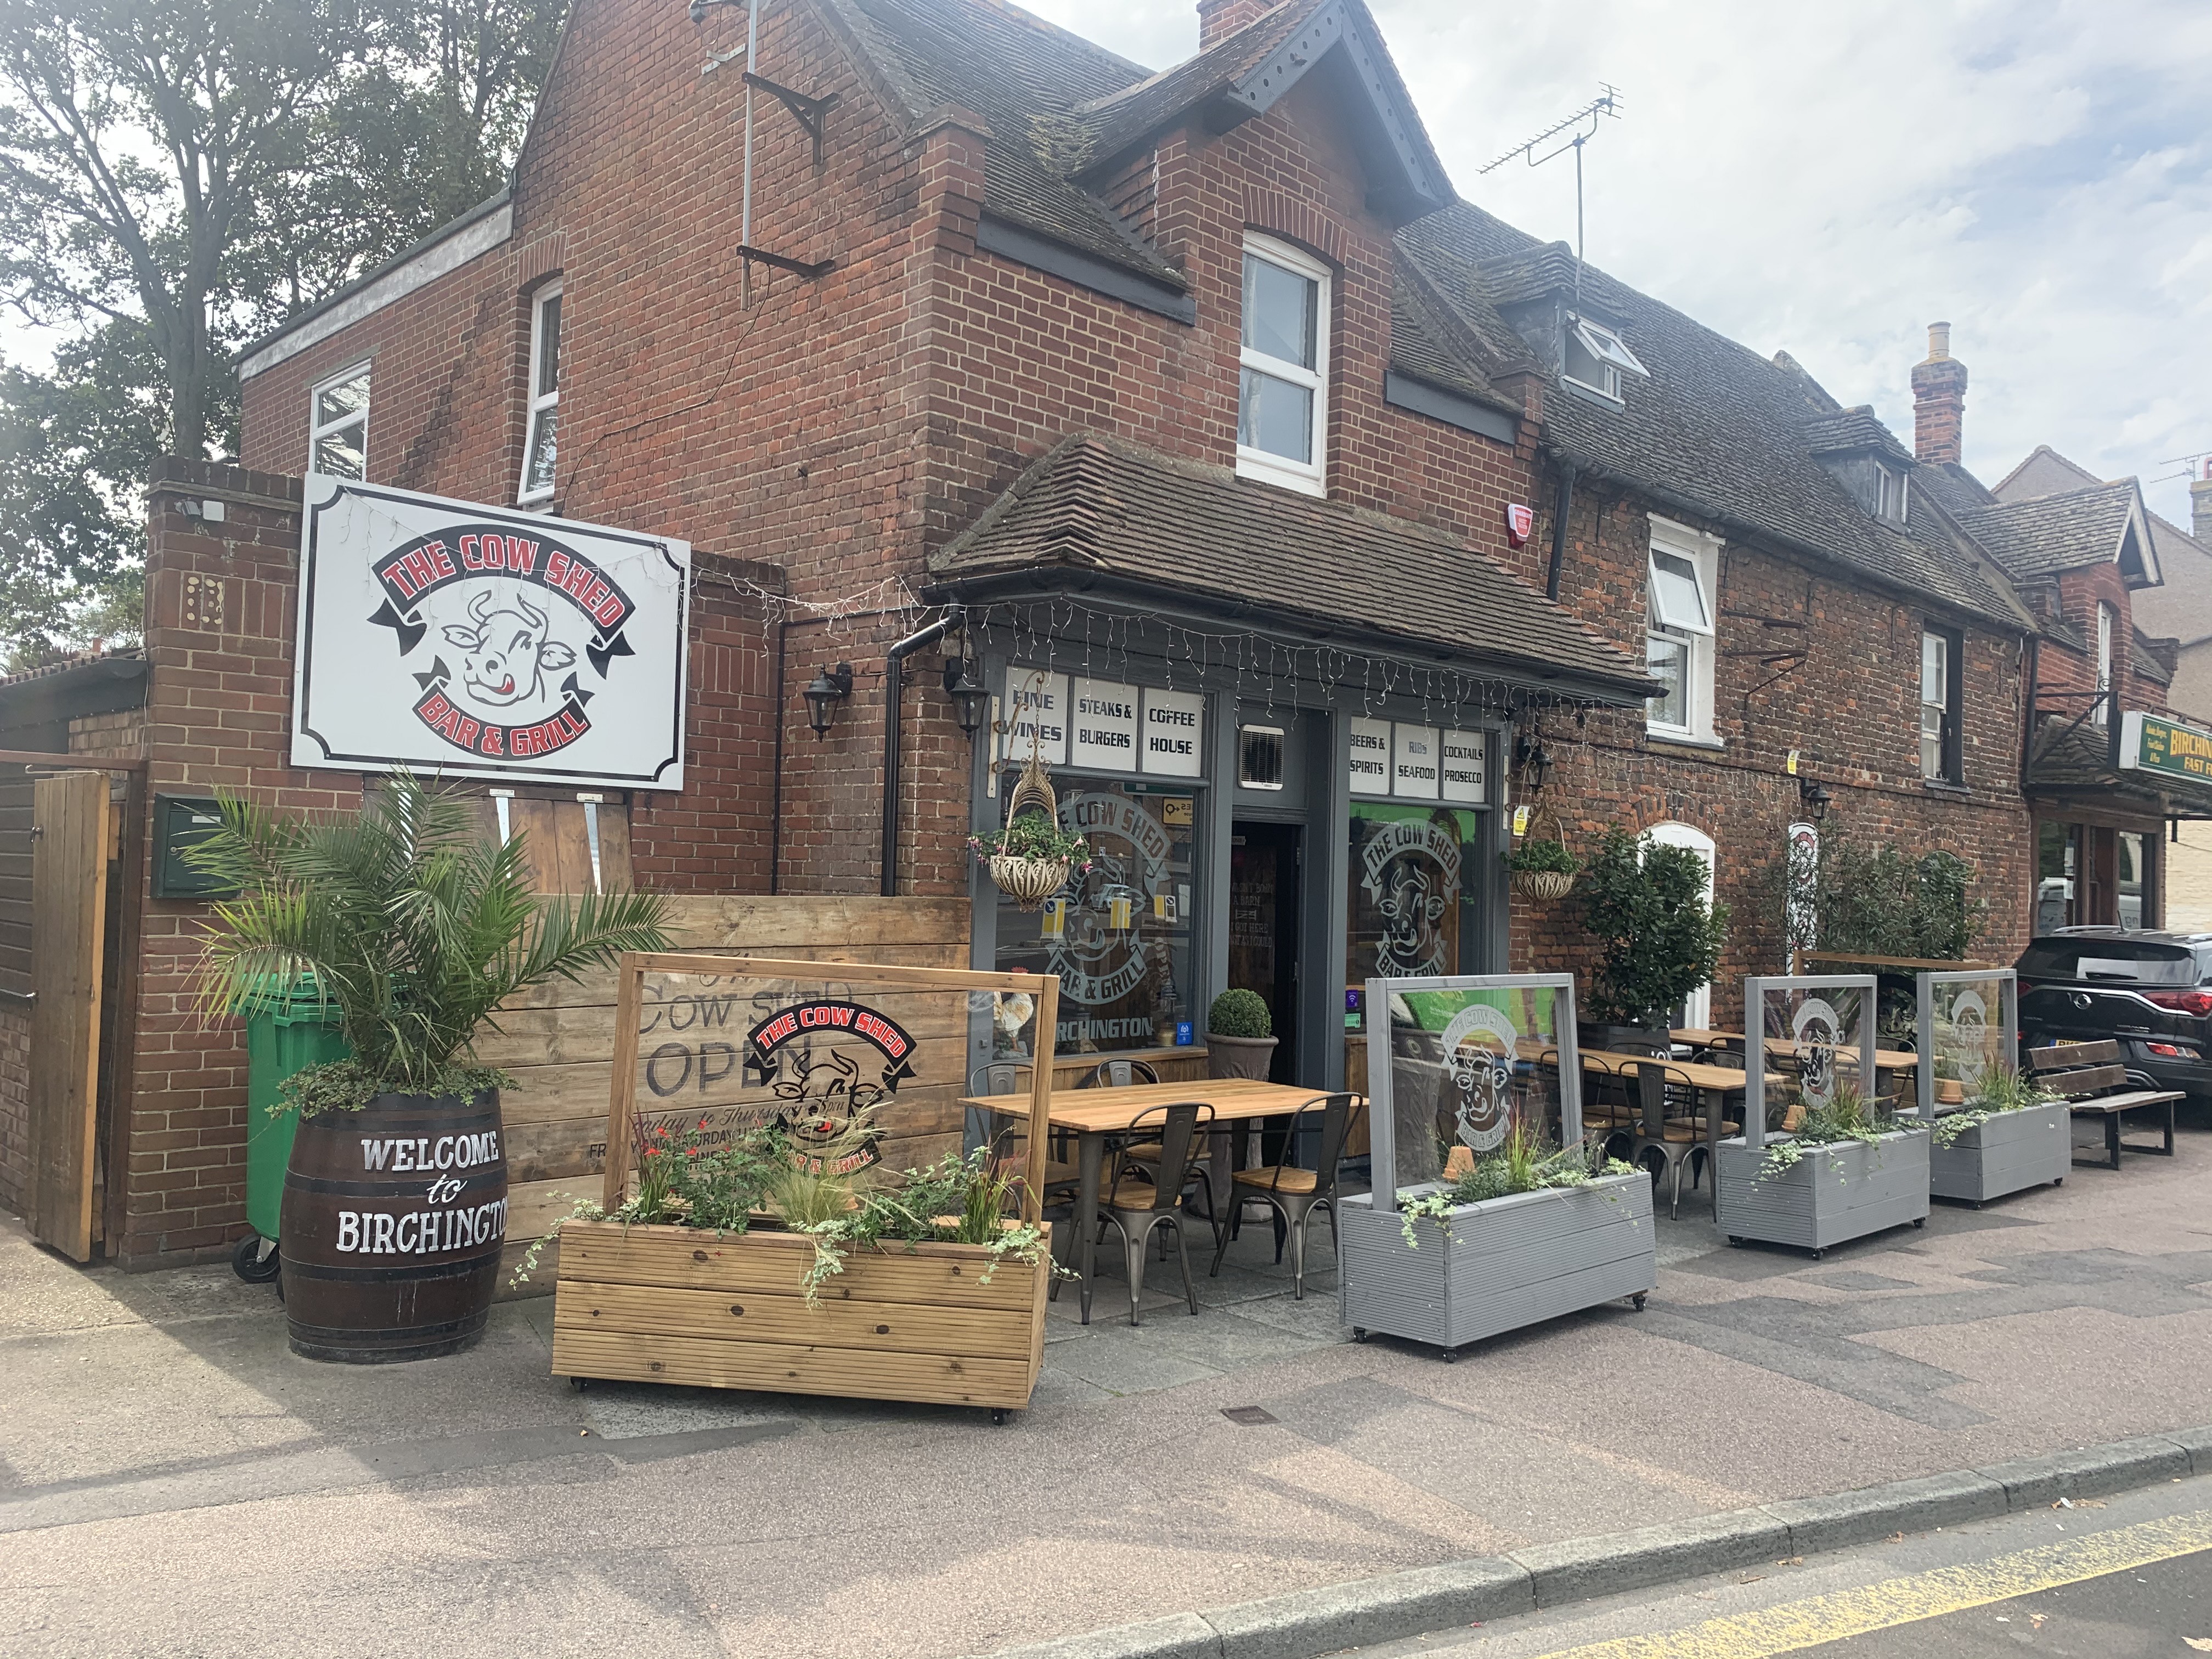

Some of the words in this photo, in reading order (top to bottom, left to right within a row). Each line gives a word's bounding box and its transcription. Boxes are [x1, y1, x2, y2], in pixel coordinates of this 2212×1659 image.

[381, 540, 456, 601] THE
[459, 534, 540, 574] COW
[544, 551, 626, 628] SHED
[1013, 690, 1054, 709] FINE
[1079, 698, 1122, 718] STEAKS
[1124, 705, 1132, 719] &
[417, 692, 480, 748] BAR
[481, 726, 504, 756] &
[510, 709, 588, 757] GRILL
[1149, 708, 1195, 727] COFFEE
[1004, 720, 1062, 742] WINES
[1080, 729, 1130, 748] BURGERS
[1351, 734, 1377, 749] BEERS
[1379, 738, 1385, 751] &
[1150, 737, 1193, 755] HOUSE
[1409, 741, 1427, 755] RIBS
[1444, 746, 1483, 761] COCKTAILS
[1350, 760, 1384, 775] SPIRITS
[1398, 765, 1435, 780] SEAFOOD
[2184, 757, 2204, 773] FAST
[1444, 770, 1482, 784] PROSECCO
[1075, 800, 1117, 826] COW
[1122, 808, 1164, 859] SHED
[1367, 833, 1393, 868] THE
[1395, 824, 1424, 847] COW
[1427, 829, 1457, 871] SHED
[1049, 958, 1081, 997] BAR
[1085, 979, 1097, 1000] &
[1101, 960, 1146, 998] GRILL
[640, 985, 737, 1035] COW
[1465, 1008, 1488, 1028] COW
[757, 1012, 798, 1050] THE
[799, 1006, 855, 1028] COW
[855, 1015, 908, 1059] SHED
[1056, 1017, 1153, 1042] RCHINGTON
[646, 1036, 811, 1097] OPEN
[1462, 1122, 1477, 1147] BAR
[360, 1130, 500, 1171] WELCOME
[808, 1159, 822, 1174] &
[827, 1148, 874, 1175] GRILL
[426, 1173, 468, 1204] to
[336, 1195, 508, 1254] BIRCHINGTO
